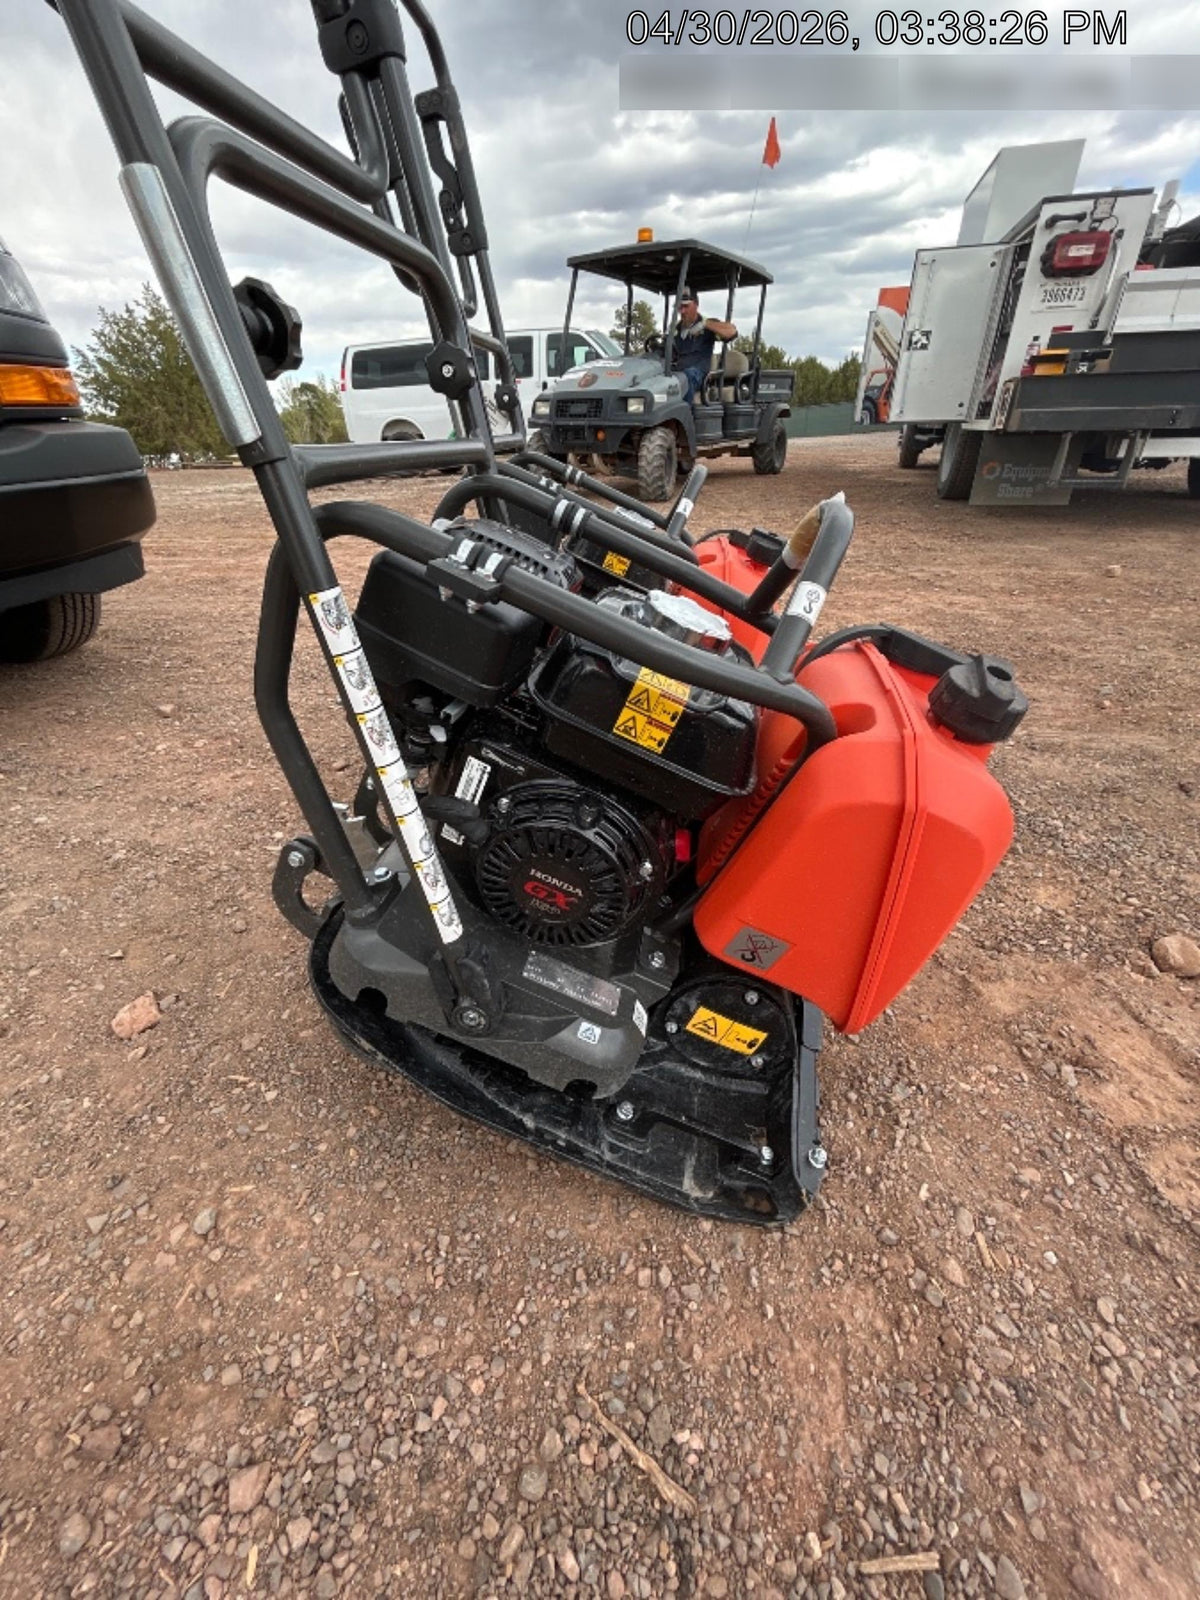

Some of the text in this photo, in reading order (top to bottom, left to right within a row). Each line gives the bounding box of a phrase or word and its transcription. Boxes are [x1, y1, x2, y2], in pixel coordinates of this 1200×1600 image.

[997, 484, 1034, 497] Share
[523, 880, 578, 911] GX
[528, 867, 584, 898] HONDA
